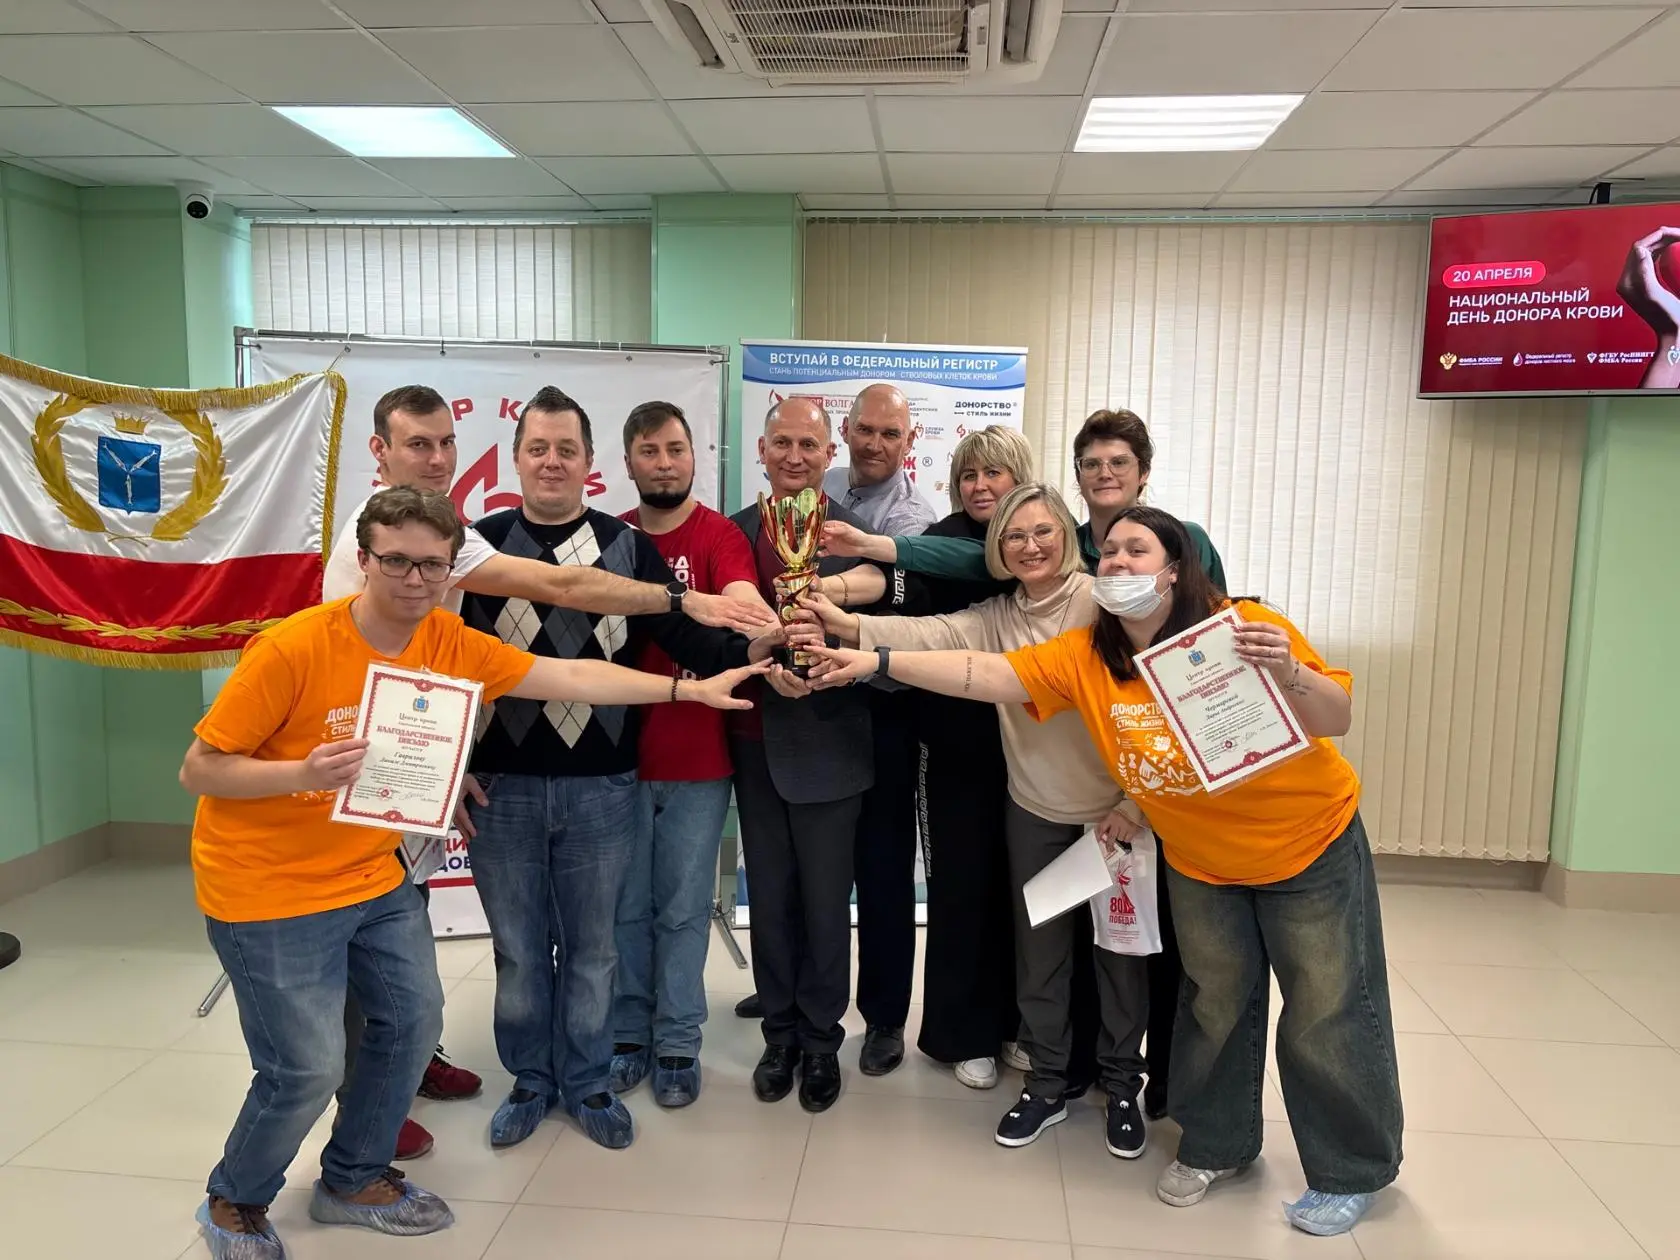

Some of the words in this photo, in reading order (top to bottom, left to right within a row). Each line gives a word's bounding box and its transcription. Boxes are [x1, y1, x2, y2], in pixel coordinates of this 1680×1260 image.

[1452, 271, 1470, 282] 20
[1473, 267, 1533, 281] АПРЕЛЯ
[1449, 287, 1590, 308] НАЦИОНАЛЬНЫЙ
[1447, 310, 1490, 326] ДЕНЬ
[1493, 307, 1562, 325] ДОНОРА
[1566, 305, 1624, 319] КРОВИ
[770, 352, 828, 365] ВСТУПАЙ
[831, 355, 840, 366] В
[842, 355, 939, 369] ФЕДЕРАЛЬНЫЙ
[942, 358, 999, 370] РЕГИСТР
[769, 367, 792, 375] СТАНЬ
[793, 367, 859, 377] ПОТЕНЦИАЛЬНЫМ
[860, 370, 896, 378] ДОНОРОМ
[900, 371, 943, 380] СТВОЛОВЫХ
[944, 372, 971, 381] КЛЕТОК
[972, 373, 998, 381] КРОВИ
[954, 401, 1012, 409] ДОНОРСТВО
[325, 705, 359, 724] ДОНО
[1110, 702, 1163, 718] ДОНОРСТВ
[1110, 897, 1123, 914] 80
[1109, 915, 1137, 925] ПОБЕДА!
